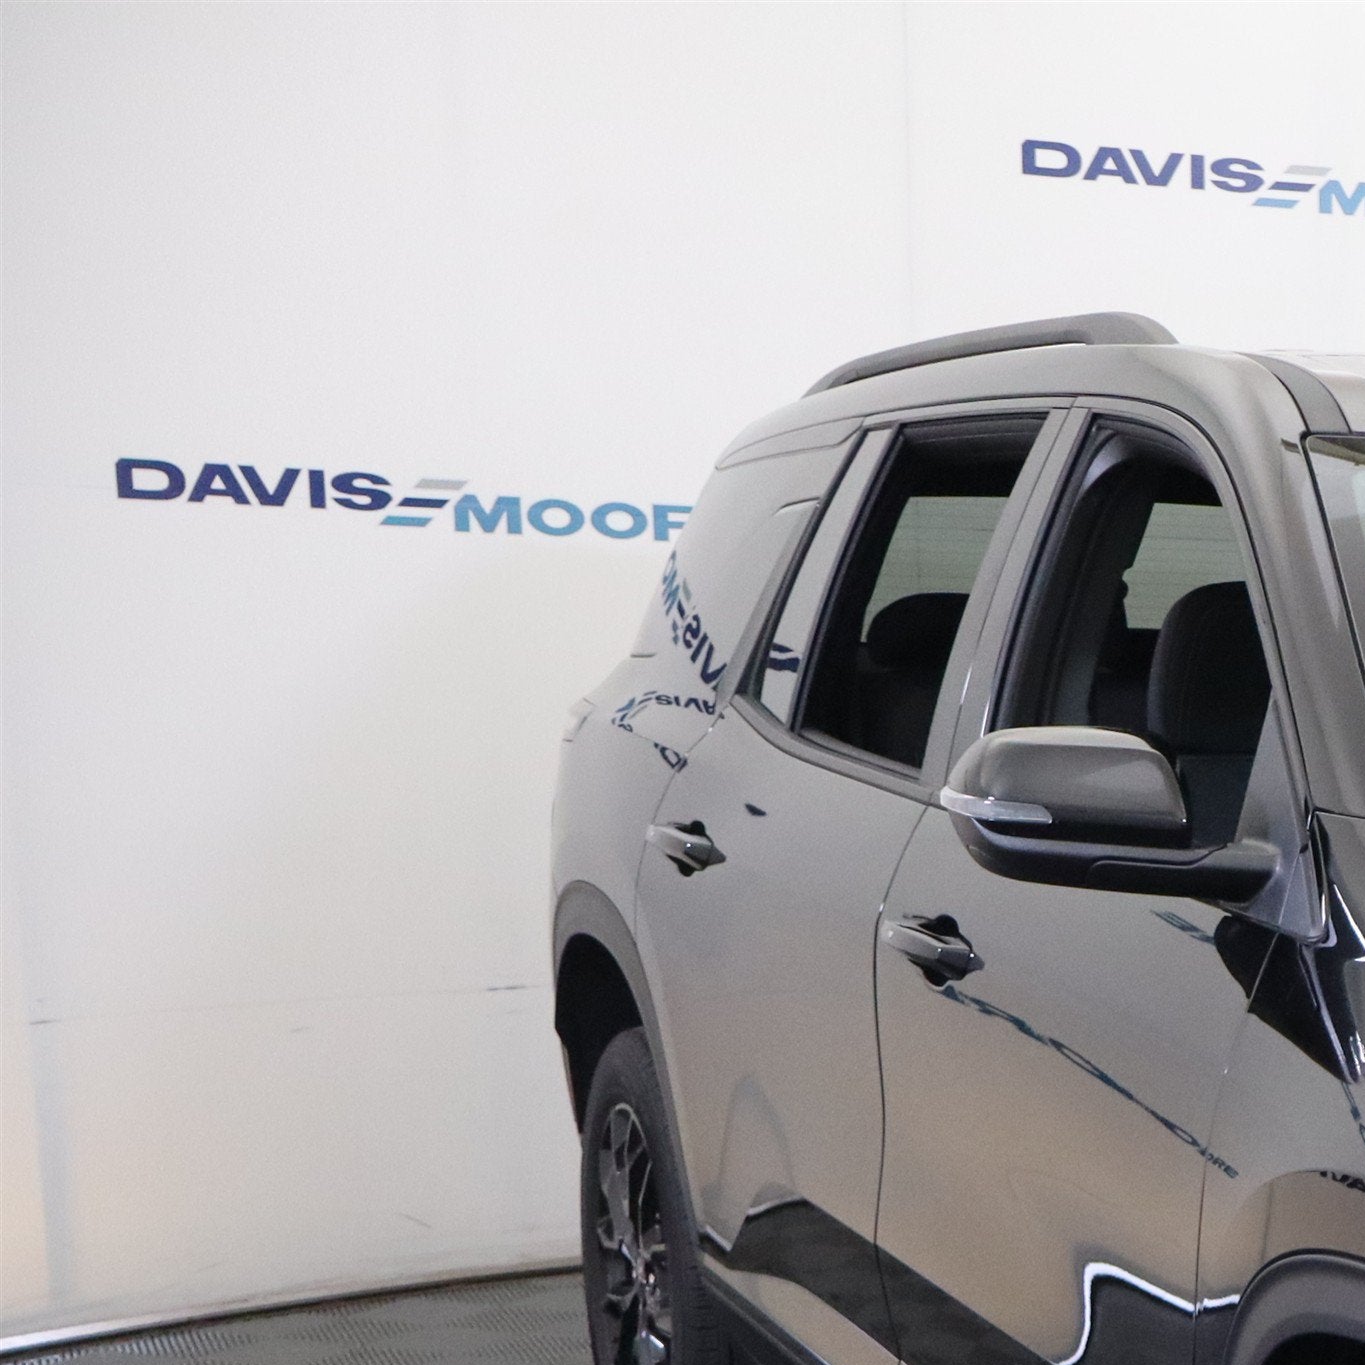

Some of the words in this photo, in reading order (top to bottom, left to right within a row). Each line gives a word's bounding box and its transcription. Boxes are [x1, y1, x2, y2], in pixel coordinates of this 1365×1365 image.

[1022, 140, 1263, 192] DAVIS
[115, 457, 393, 511] DAVIS
[453, 493, 693, 541] MOOR
